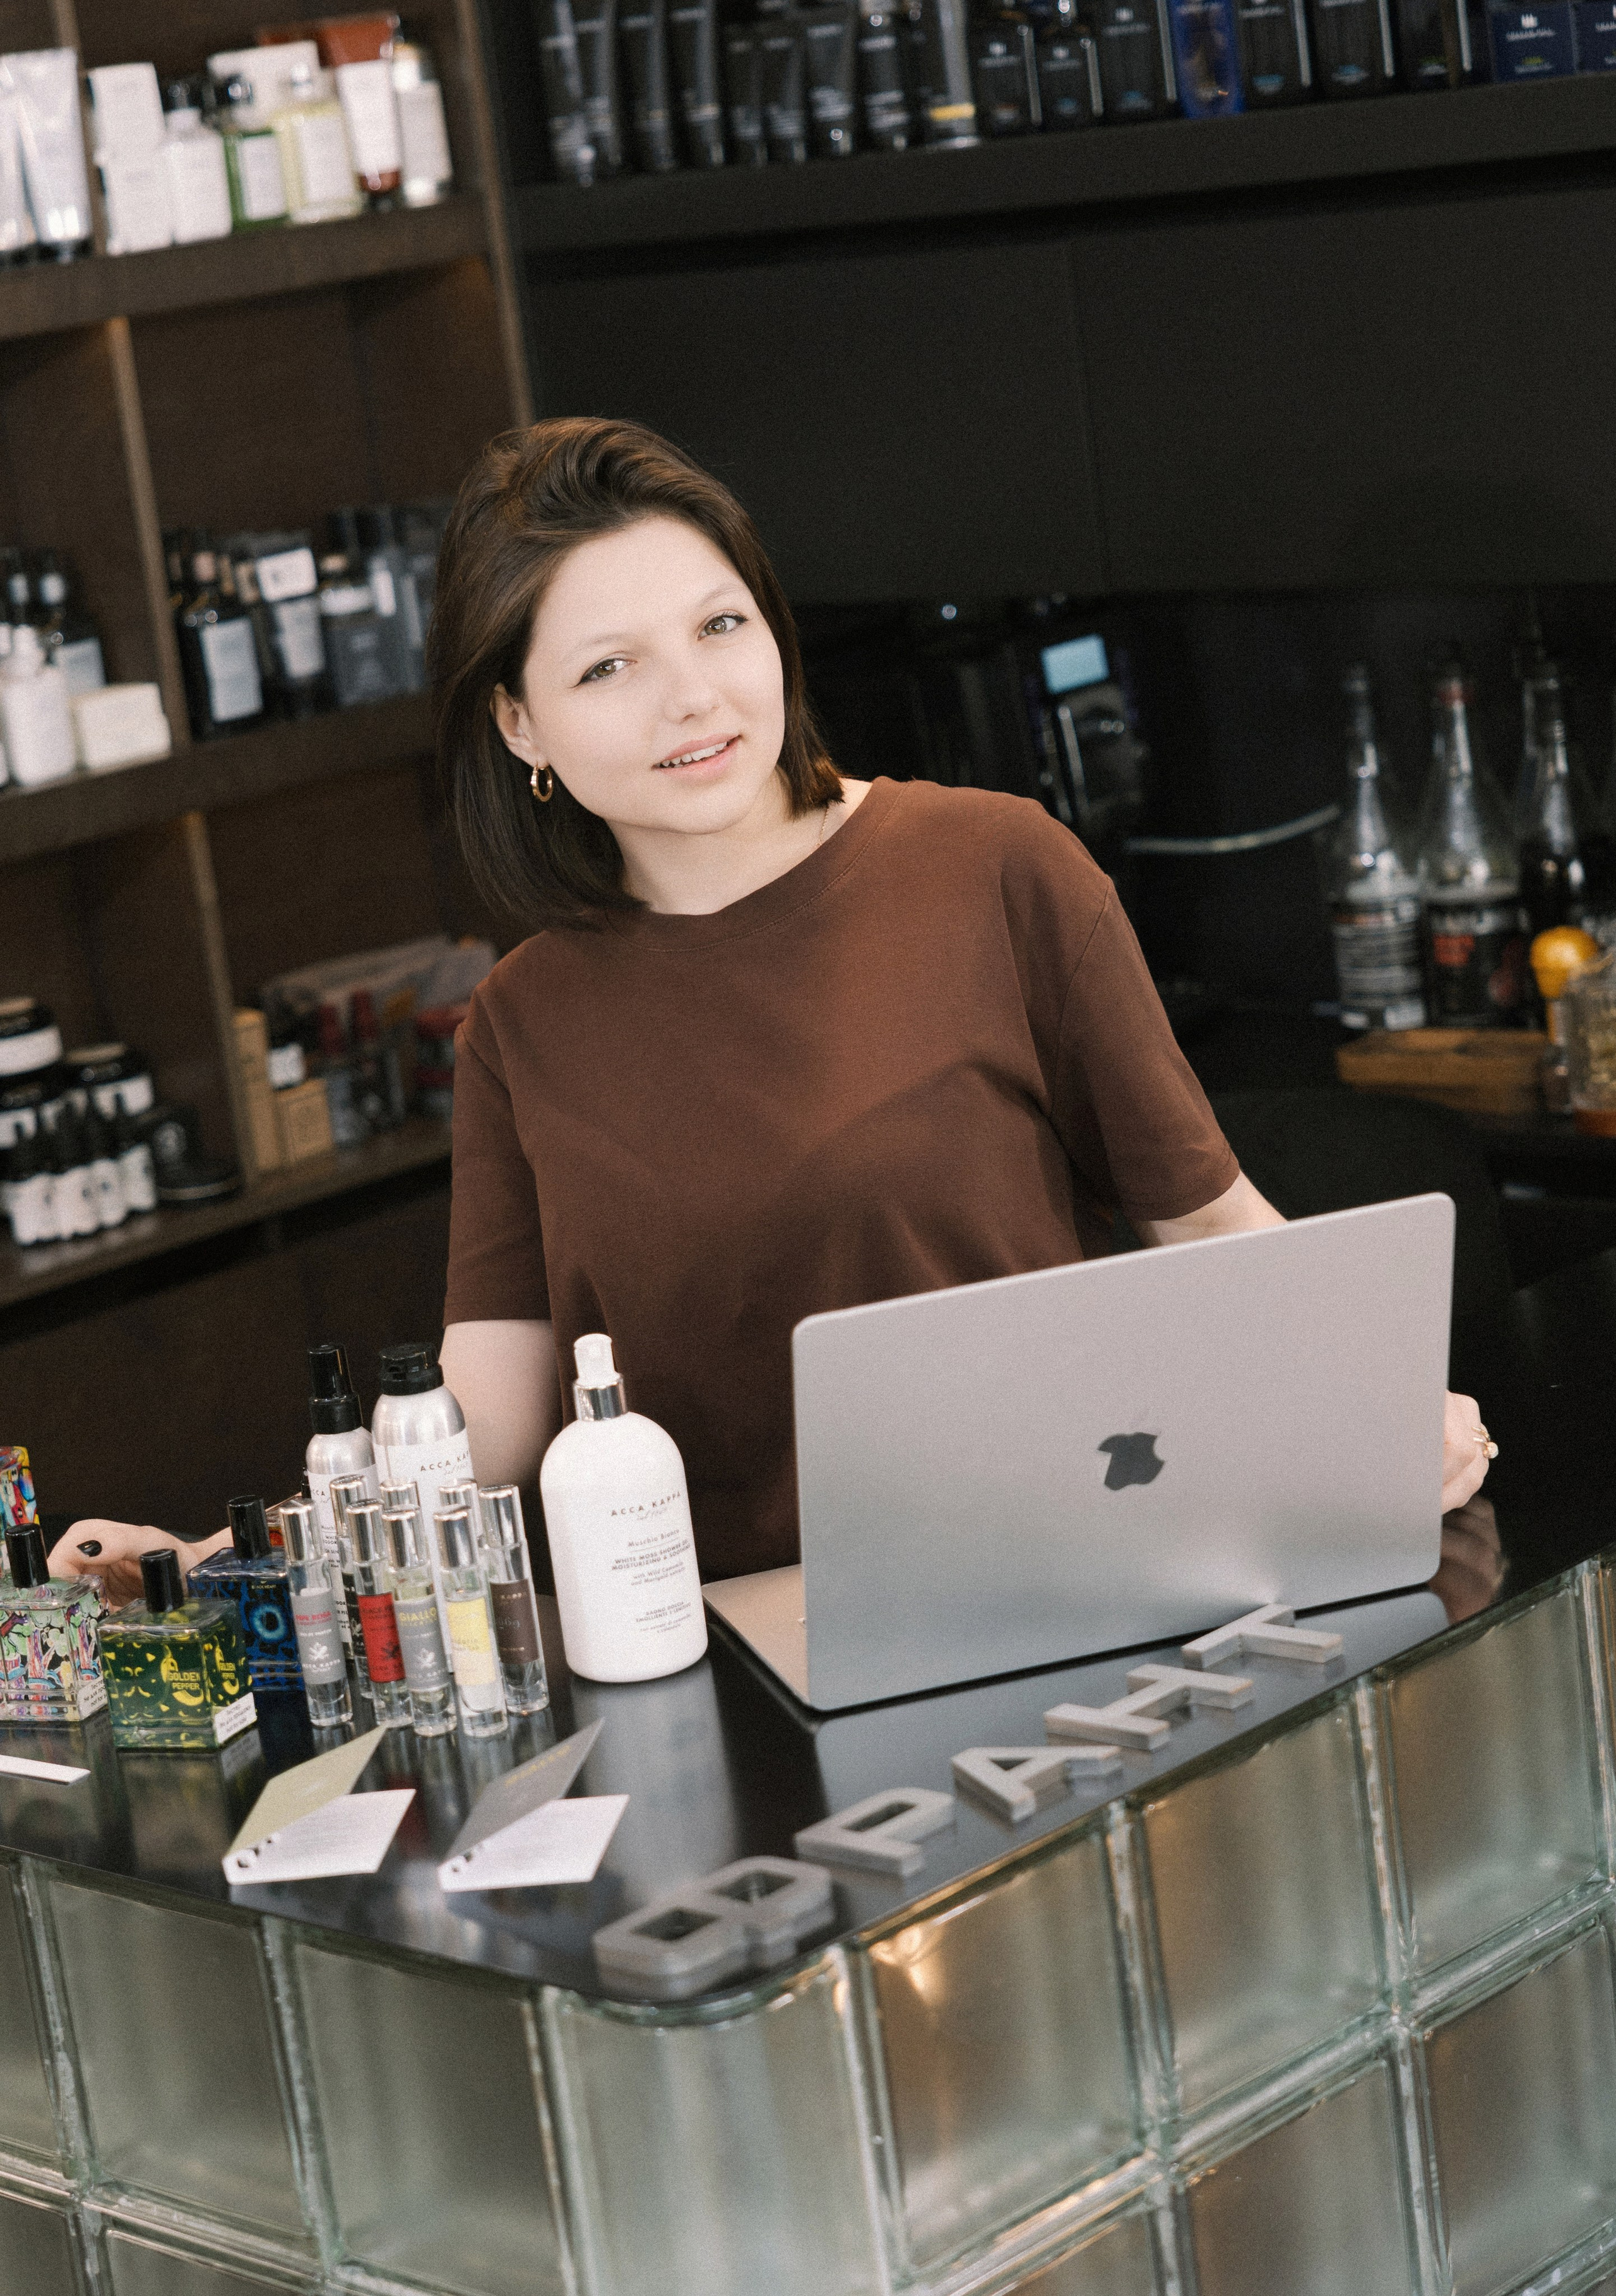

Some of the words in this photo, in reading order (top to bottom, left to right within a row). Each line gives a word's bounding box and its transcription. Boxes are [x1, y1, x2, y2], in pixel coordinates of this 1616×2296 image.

[420, 1460, 451, 1471] ACCA
[610, 1505, 645, 1517] ACCA
[651, 1490, 681, 1507] KAPPA
[627, 1536, 658, 1547] Muschio
[660, 1529, 679, 1540] Bianco
[611, 1557, 662, 1571] MOISTURIZING
[668, 1542, 692, 1558] SOOTHING
[639, 1552, 658, 1561] MOSS
[659, 1542, 680, 1555] SHOWER
[647, 1568, 661, 1577] Wild
[398, 1606, 437, 1622] GIALLO
[635, 1611, 668, 1623] EMOLLIENTE
[645, 1607, 667, 1616] BAGNO
[168, 1671, 201, 1682] GOLDEN
[172, 1682, 200, 1691] PEPPER
[591, 1602, 1343, 1994] ФРАНТ
